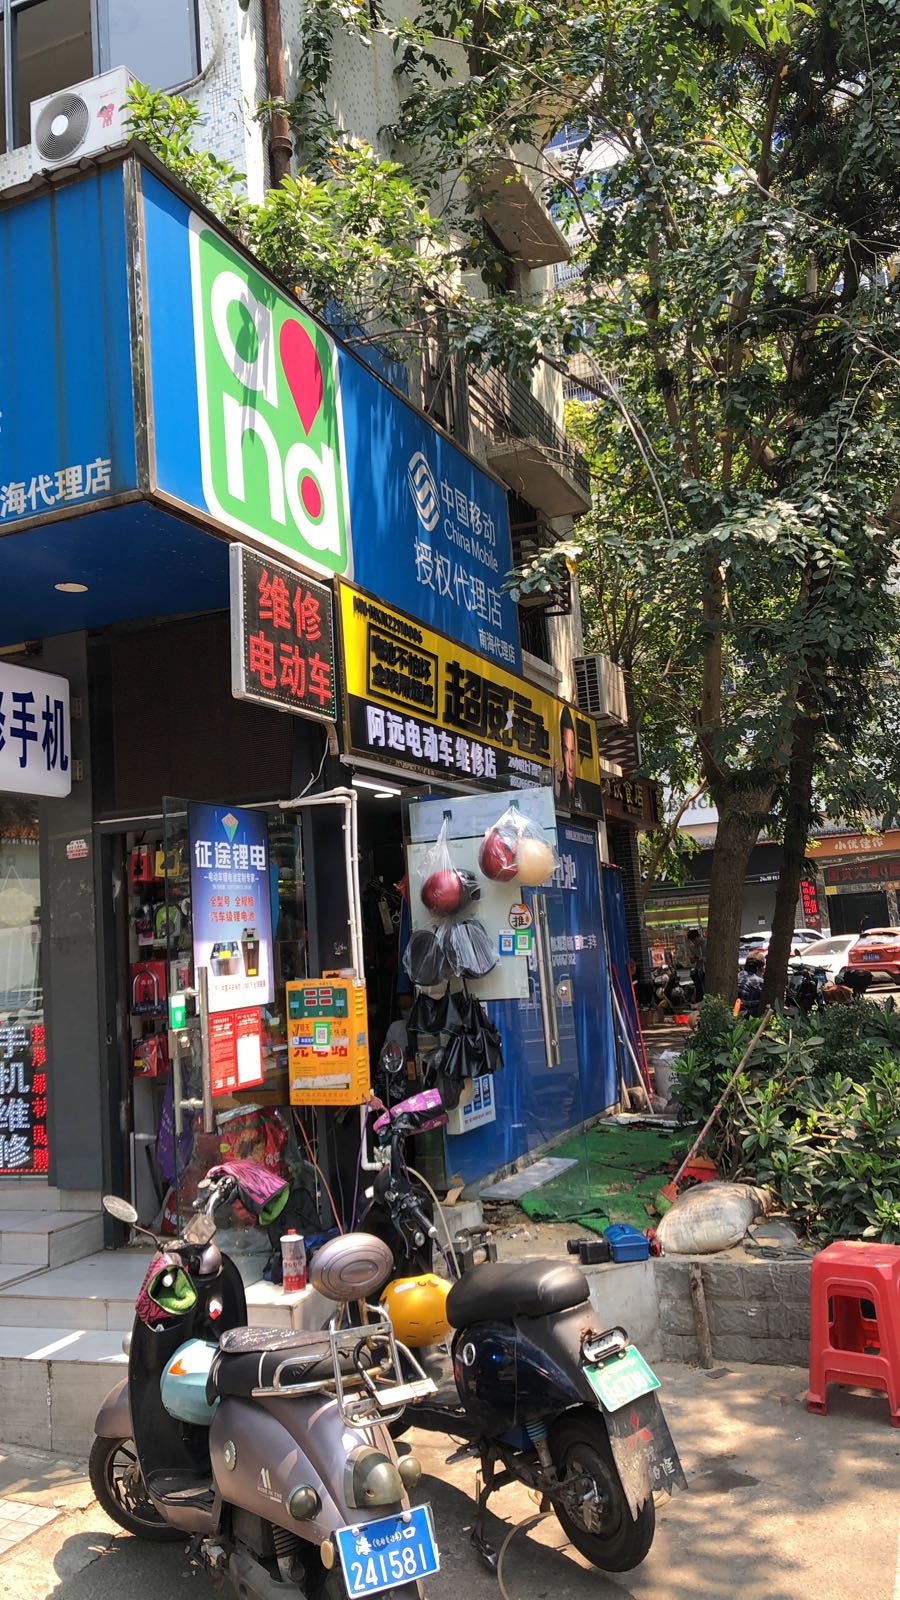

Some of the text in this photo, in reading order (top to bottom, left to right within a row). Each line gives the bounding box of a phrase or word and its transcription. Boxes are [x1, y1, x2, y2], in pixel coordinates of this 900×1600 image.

[439, 478, 497, 548] 中国移动
[443, 518, 499, 573] China Mobile
[258, 569, 322, 642] 维修
[413, 535, 503, 630] 授权代理店
[248, 630, 333, 706] 电动车
[477, 628, 517, 665] 南海代理店
[0, 691, 69, 772] 手机
[366, 704, 497, 780] 阿远电动车维修店
[194, 839, 267, 871] 征途锂电
[512, 915, 528, 927] 推
[0, 1025, 30, 1168] 手机维修
[350, 1543, 428, 1591] 241581
